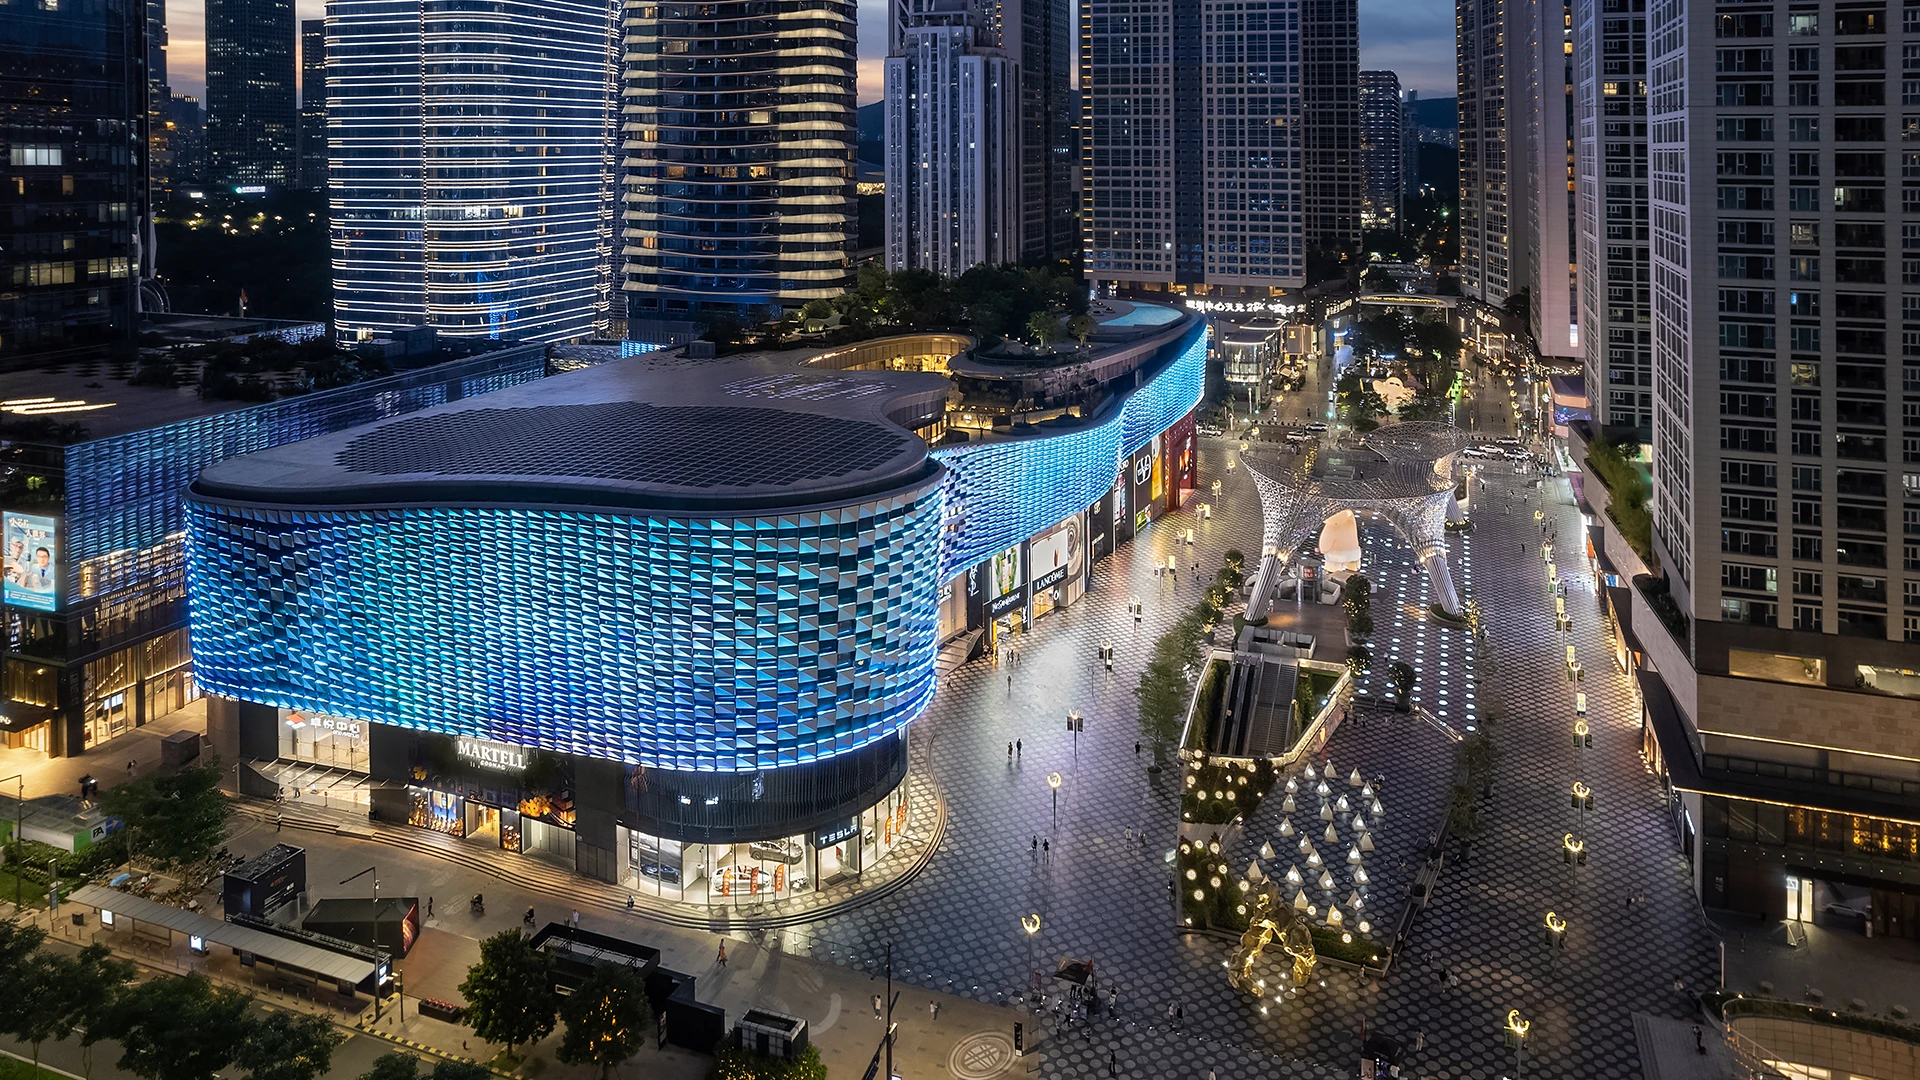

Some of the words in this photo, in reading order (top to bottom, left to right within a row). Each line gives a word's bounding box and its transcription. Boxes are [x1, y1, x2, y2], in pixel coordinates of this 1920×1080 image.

[310, 717, 360, 733] 卓悦中心
[457, 740, 527, 769] MARTELL
[480, 760, 506, 770] COGNAC
[820, 823, 858, 845] TESLA
